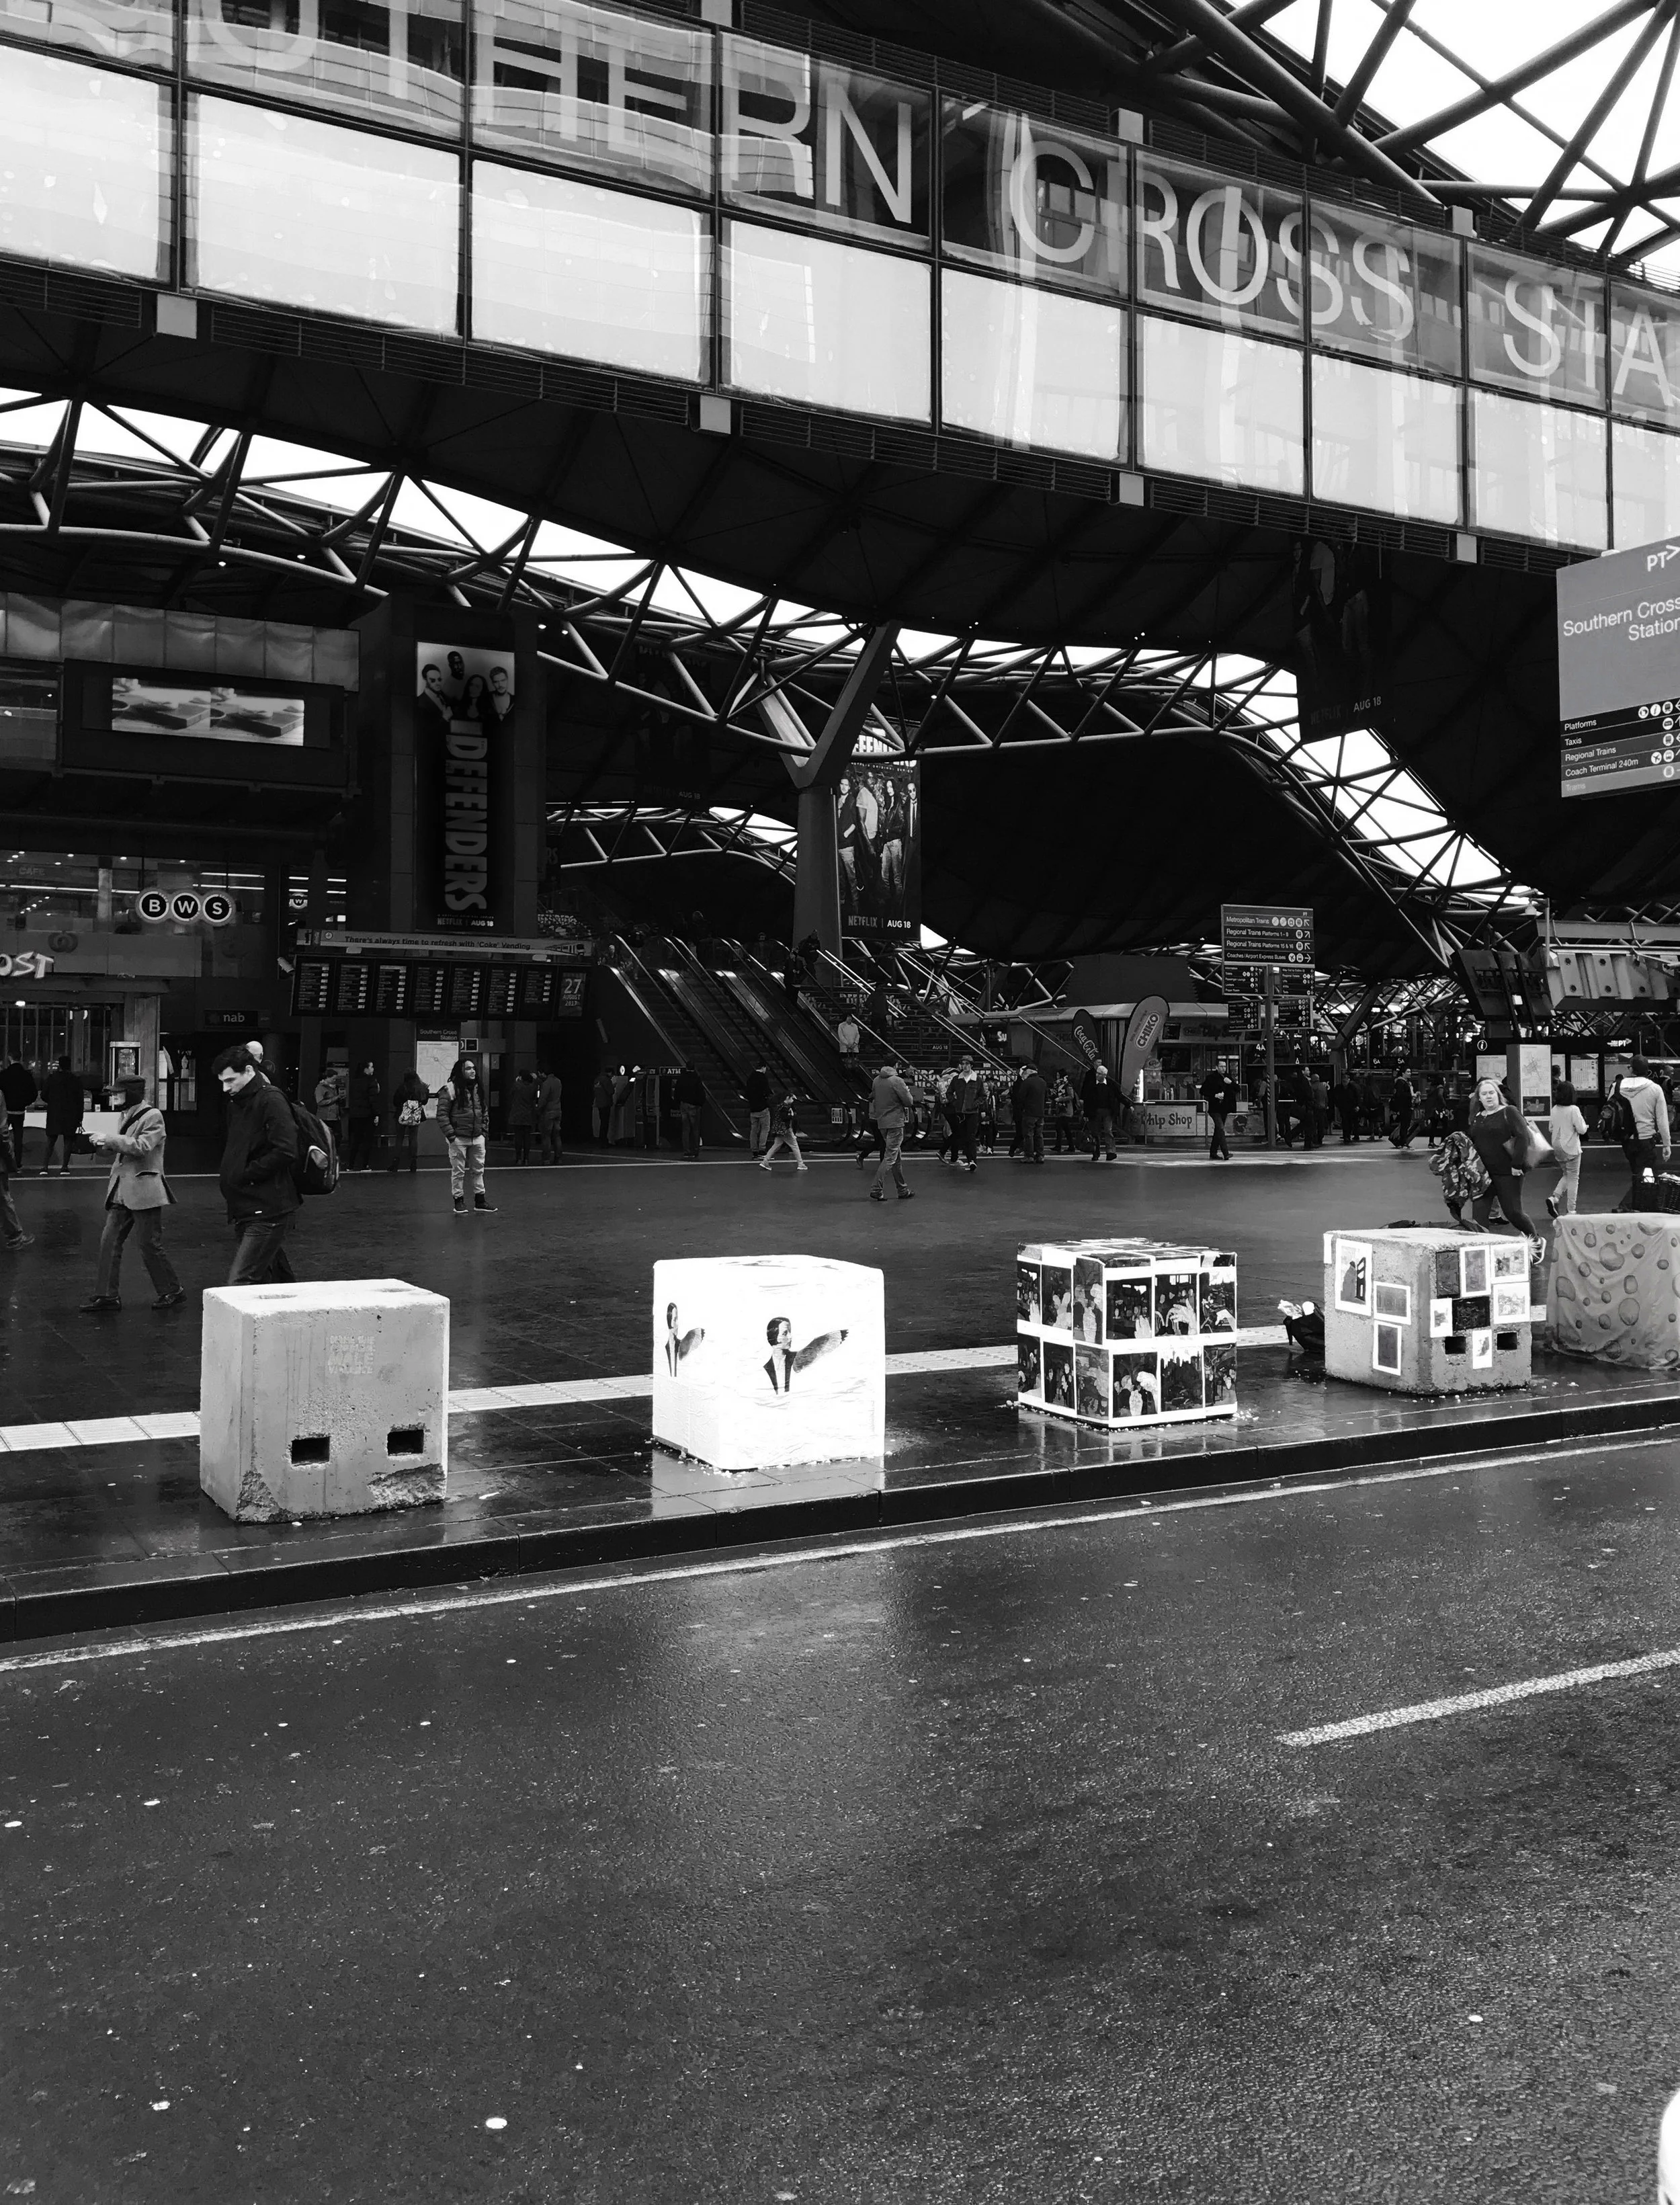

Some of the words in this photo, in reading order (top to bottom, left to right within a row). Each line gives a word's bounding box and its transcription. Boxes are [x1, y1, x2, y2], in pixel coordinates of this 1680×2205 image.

[1010, 139, 1415, 342] CROSS
[1563, 610, 1632, 636] Southern
[1353, 698, 1372, 713] AUG
[1373, 696, 1382, 707] 18
[1564, 719, 1597, 731] Platforms
[1564, 737, 1582, 746] Taxis
[1565, 749, 1595, 761] Regional
[1597, 747, 1616, 756] Trains
[1565, 766, 1587, 777] Coach
[1589, 762, 1618, 773] Terminal
[1619, 758, 1639, 768] 240m
[1565, 784, 1586, 792] Trams
[445, 734, 488, 911] DEFENDERS
[848, 915, 878, 928] NETFLIX
[887, 919, 902, 928] AUG
[903, 921, 911, 929] 18
[1226, 928, 1247, 936] Regional
[345, 935, 372, 944] There's
[372, 937, 401, 945] always
[502, 942, 531, 951] Vending
[1226, 940, 1247, 948] Regional
[564, 978, 582, 994] 27
[223, 1012, 245, 1022] nab
[1137, 1013, 1159, 1047] CHIKO
[1255, 1043, 1266, 1052] 4A
[1168, 1112, 1192, 1129] Shop
